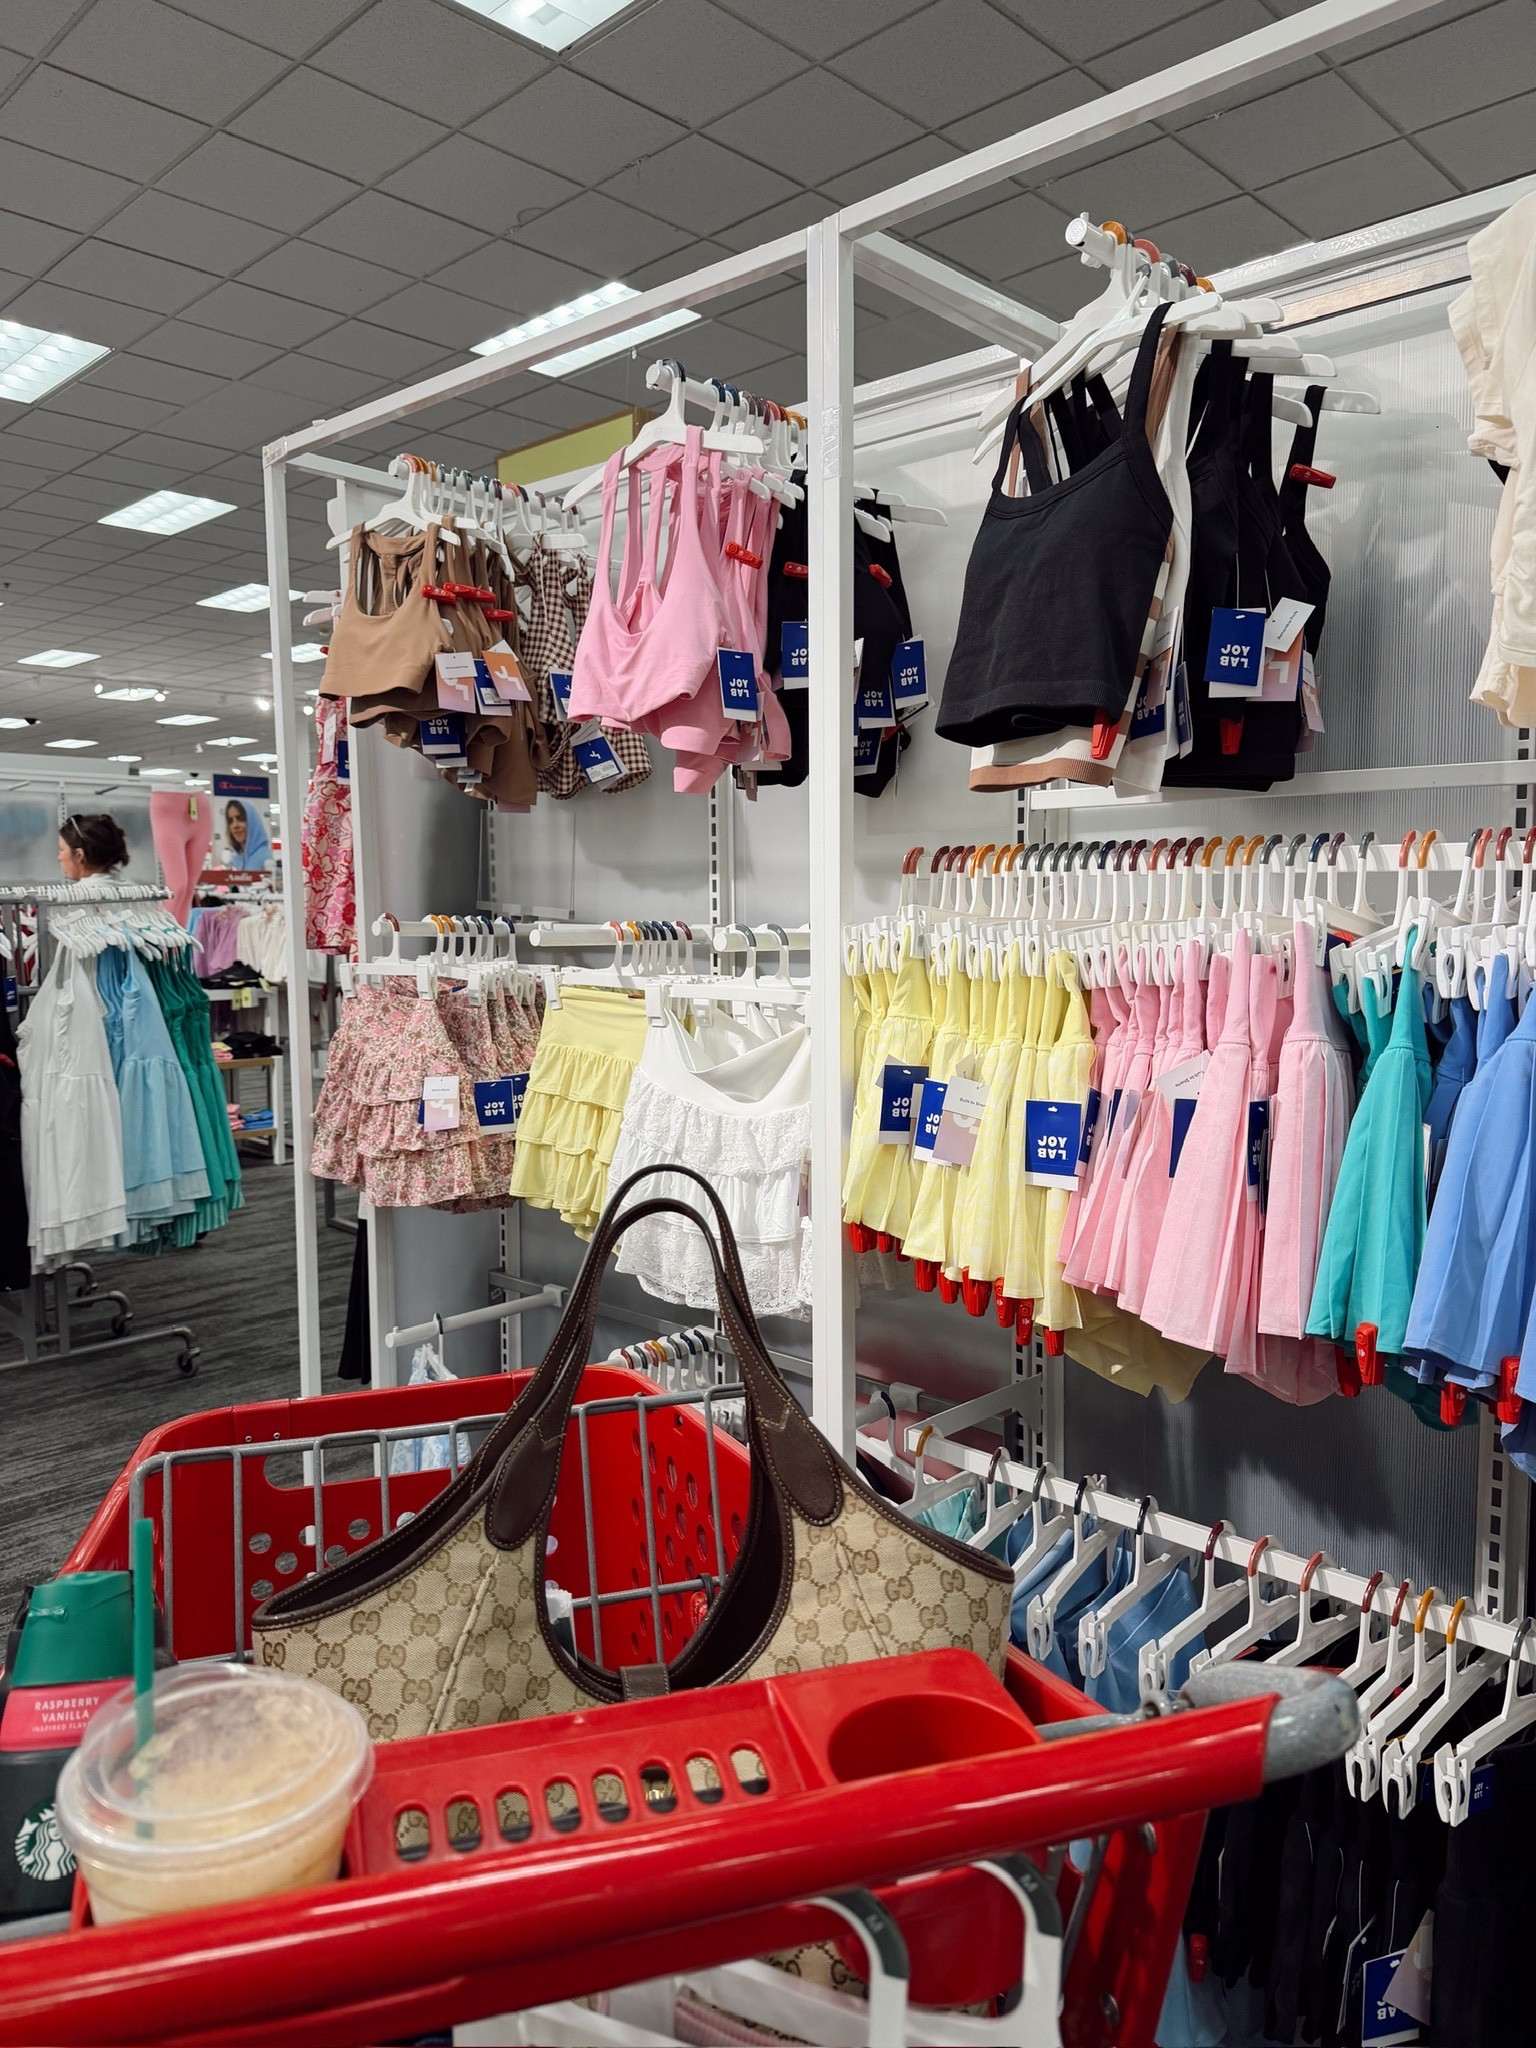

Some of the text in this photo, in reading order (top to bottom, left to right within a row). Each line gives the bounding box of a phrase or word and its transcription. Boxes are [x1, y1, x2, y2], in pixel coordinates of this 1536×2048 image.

[791, 648, 809, 657] JO
[1220, 644, 1251, 657] JOY
[791, 657, 808, 666] AB
[1219, 655, 1249, 669] LAB
[900, 666, 918, 677] JOY
[729, 678, 748, 688] JOY
[900, 675, 919, 686] LAB
[730, 688, 750, 698] LAB
[863, 690, 883, 698] JOY
[864, 699, 884, 707] LAB
[428, 718, 449, 726] JOY
[429, 726, 450, 735] LAB
[858, 740, 872, 748] OY
[484, 1101, 505, 1109] JOY
[892, 1097, 912, 1107] JO
[484, 1108, 505, 1117] LAB
[892, 1108, 909, 1117] AB
[926, 1113, 942, 1123] JO
[925, 1124, 938, 1135] AB
[1037, 1135, 1068, 1148] JOY
[1037, 1147, 1067, 1160] LAB
[34, 1696, 99, 1711] RASPBERRY
[41, 1709, 90, 1723] VANILLA
[32, 1721, 87, 1733] INSPIRED FLAV
[1020, 1873, 1038, 1893] M
[866, 1914, 885, 1933] M
[1376, 2006, 1397, 2020] AB
